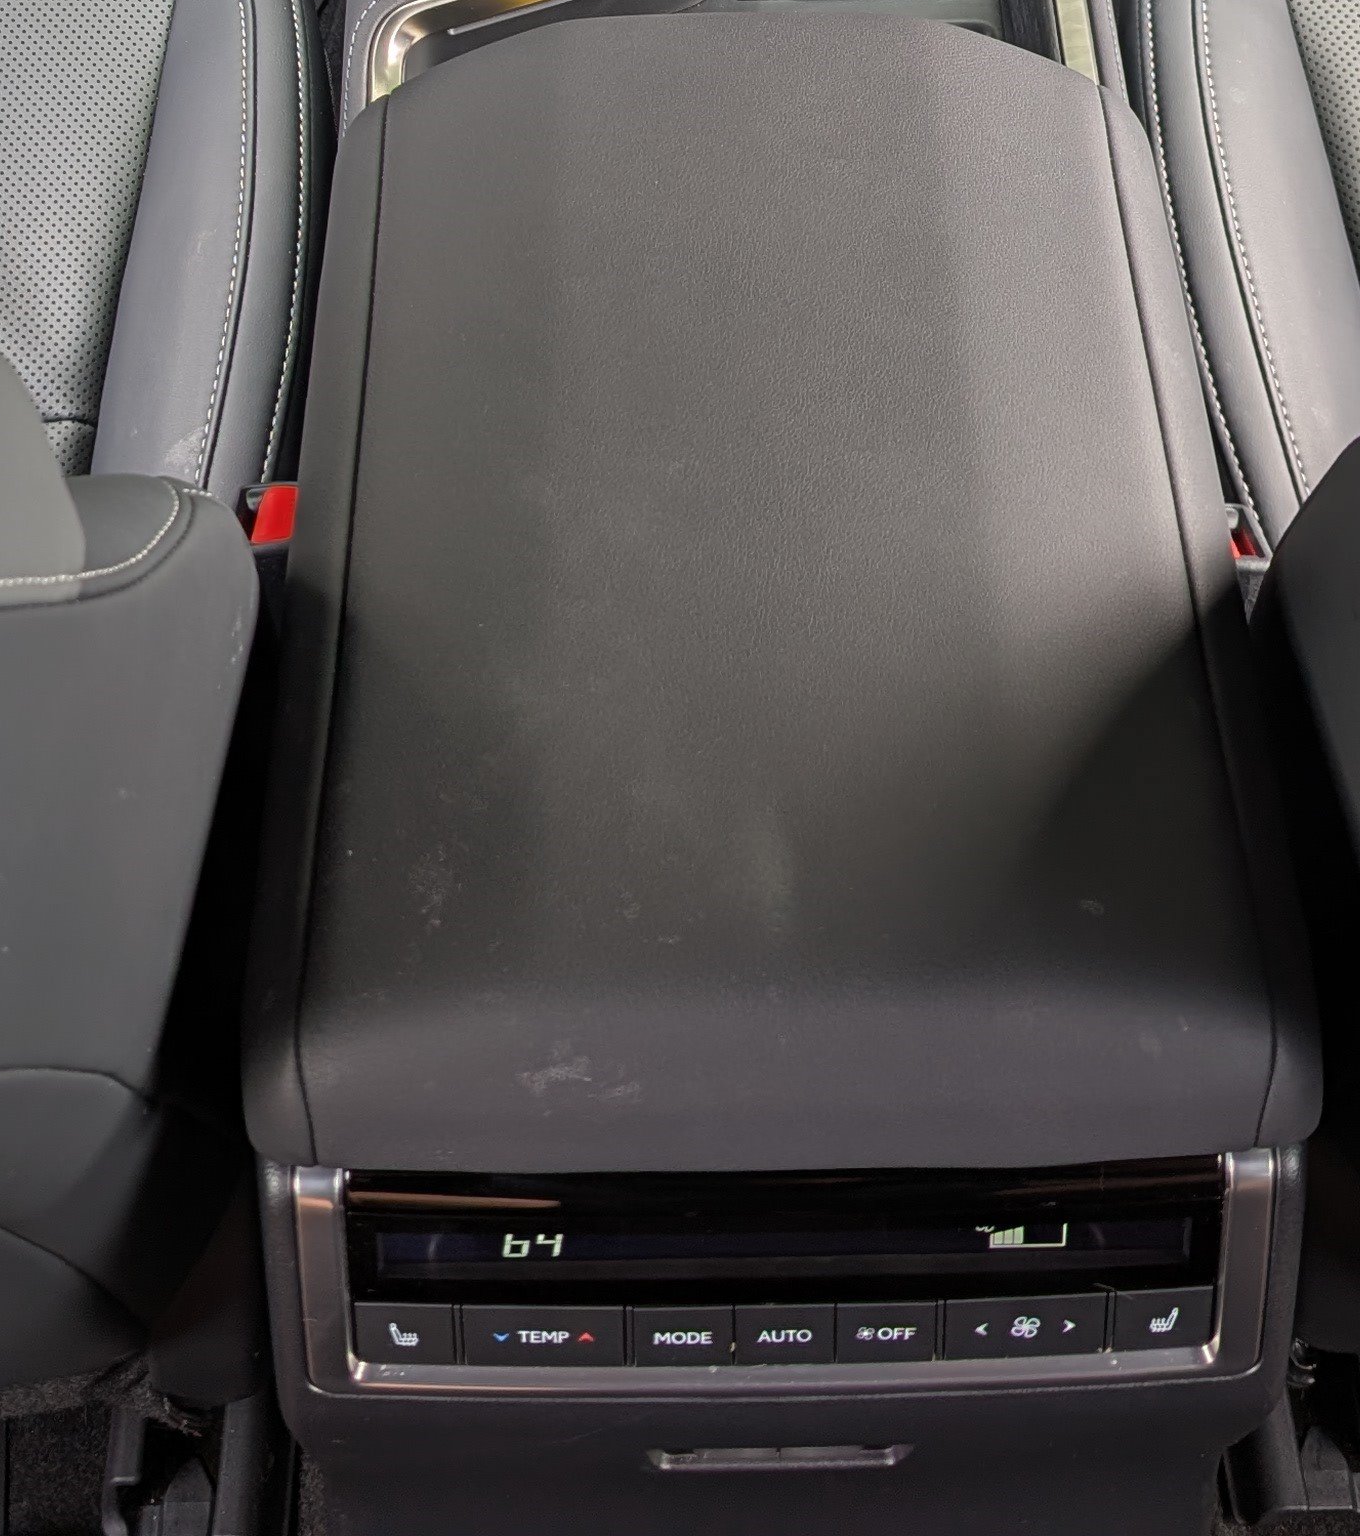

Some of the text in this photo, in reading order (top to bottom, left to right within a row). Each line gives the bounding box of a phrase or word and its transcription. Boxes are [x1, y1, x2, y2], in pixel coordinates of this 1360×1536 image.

[517, 1330, 571, 1344] TEMP
[653, 1330, 713, 1345] MODE
[758, 1328, 813, 1344] AUTO
[878, 1326, 917, 1341] OFF
